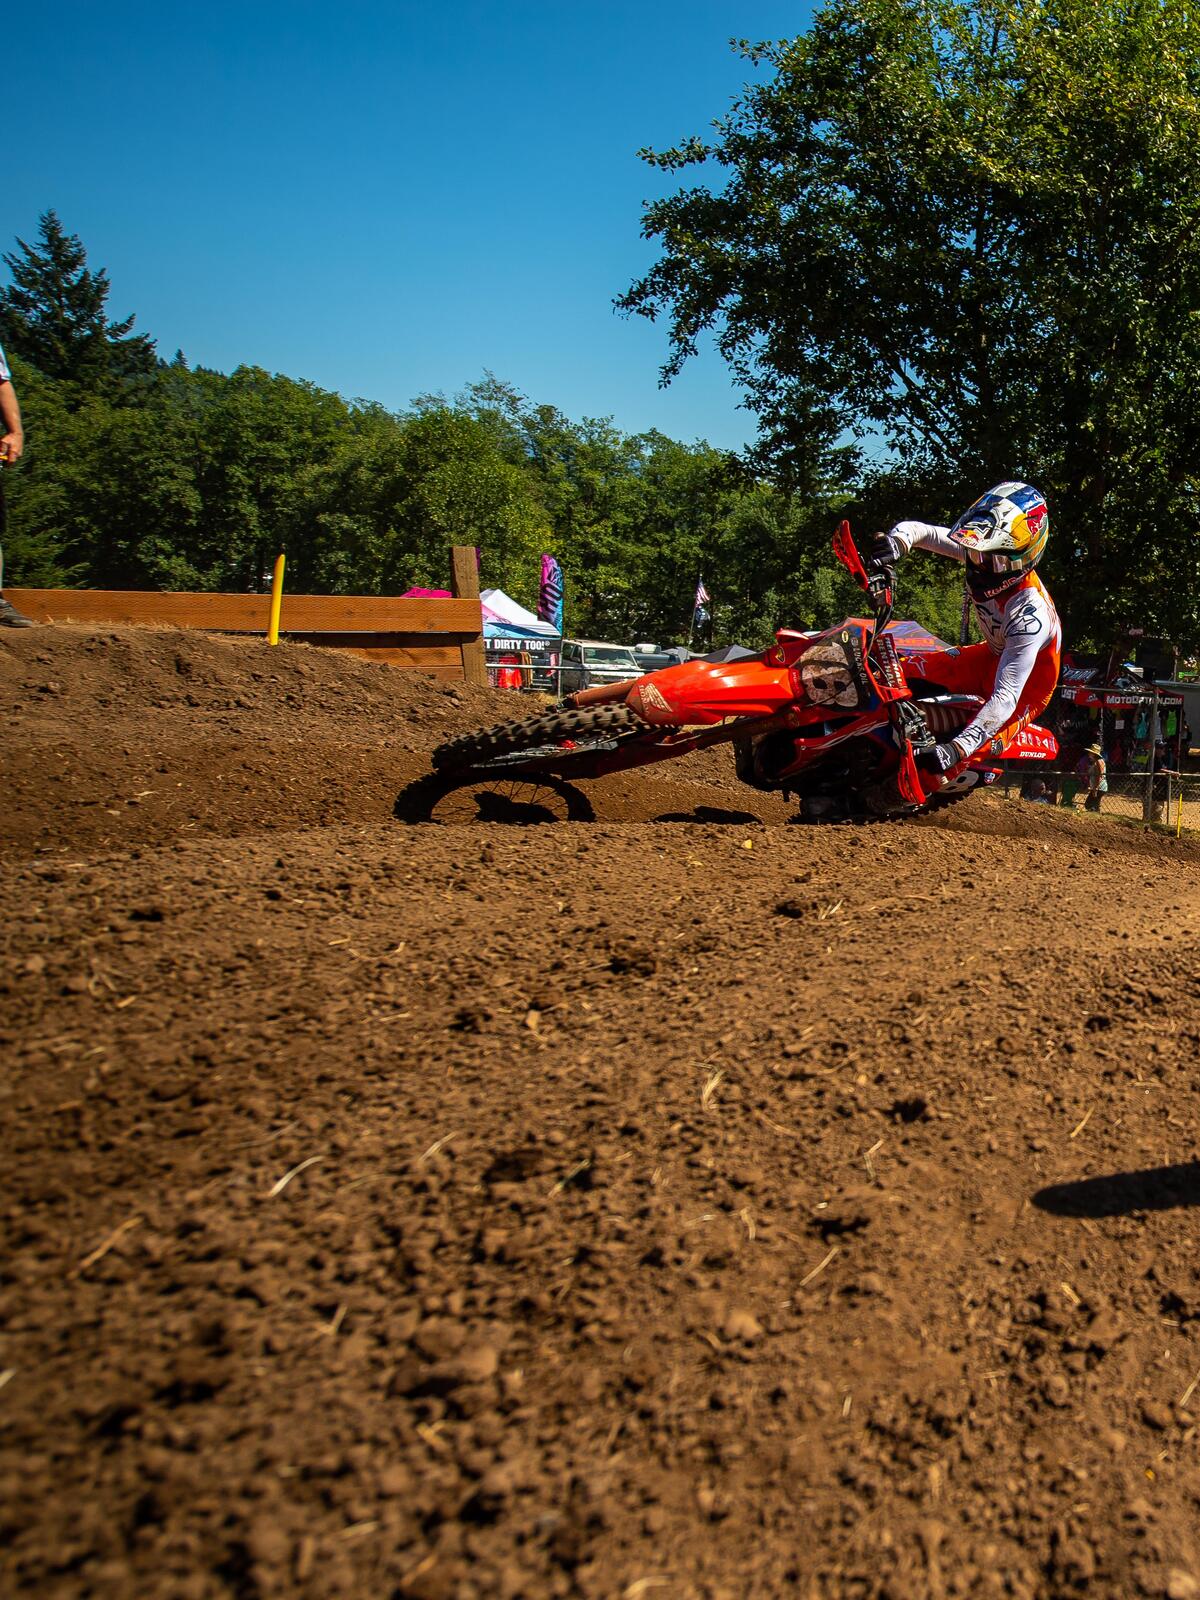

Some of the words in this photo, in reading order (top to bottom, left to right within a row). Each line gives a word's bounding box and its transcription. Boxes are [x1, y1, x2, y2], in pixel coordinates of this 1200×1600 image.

[494, 640, 521, 651] DIRTY
[876, 639, 896, 687] RENTHAL
[884, 637, 903, 687] RENTHAL
[1018, 751, 1047, 759] DUNLOP
